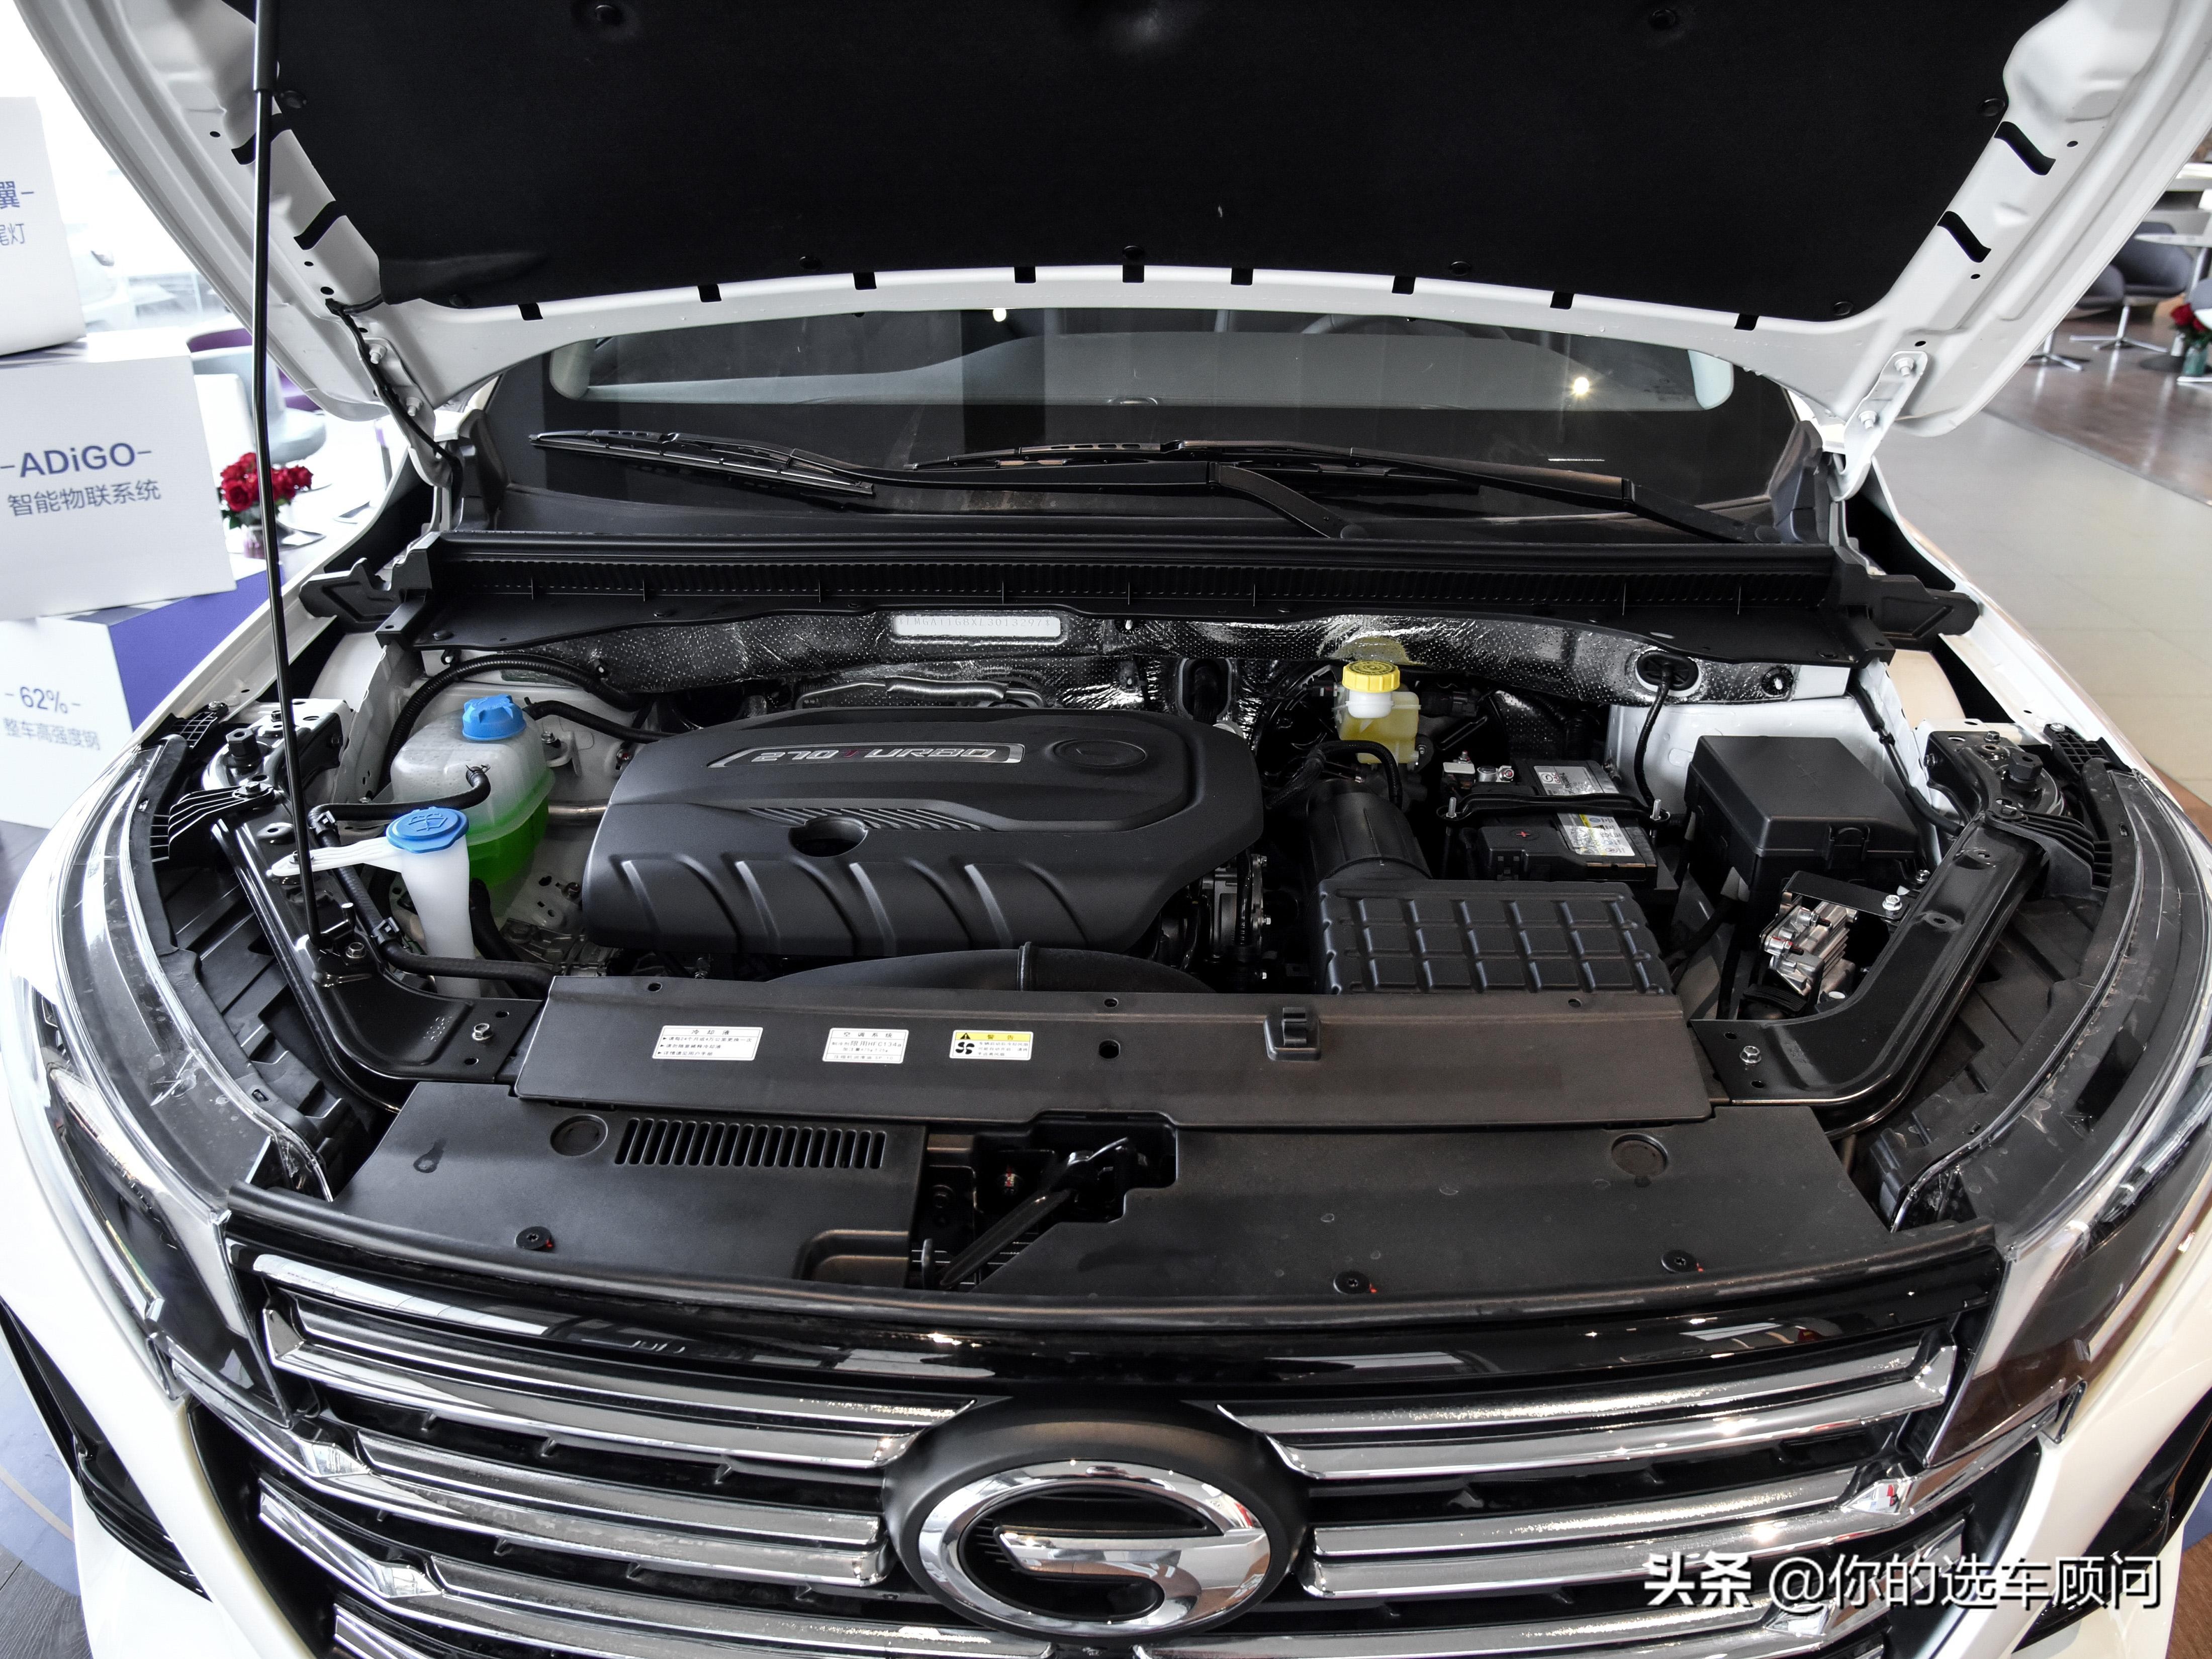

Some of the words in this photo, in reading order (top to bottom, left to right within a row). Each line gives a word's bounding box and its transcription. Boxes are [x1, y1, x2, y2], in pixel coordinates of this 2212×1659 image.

[7, 479, 161, 516] 智能物联系统
